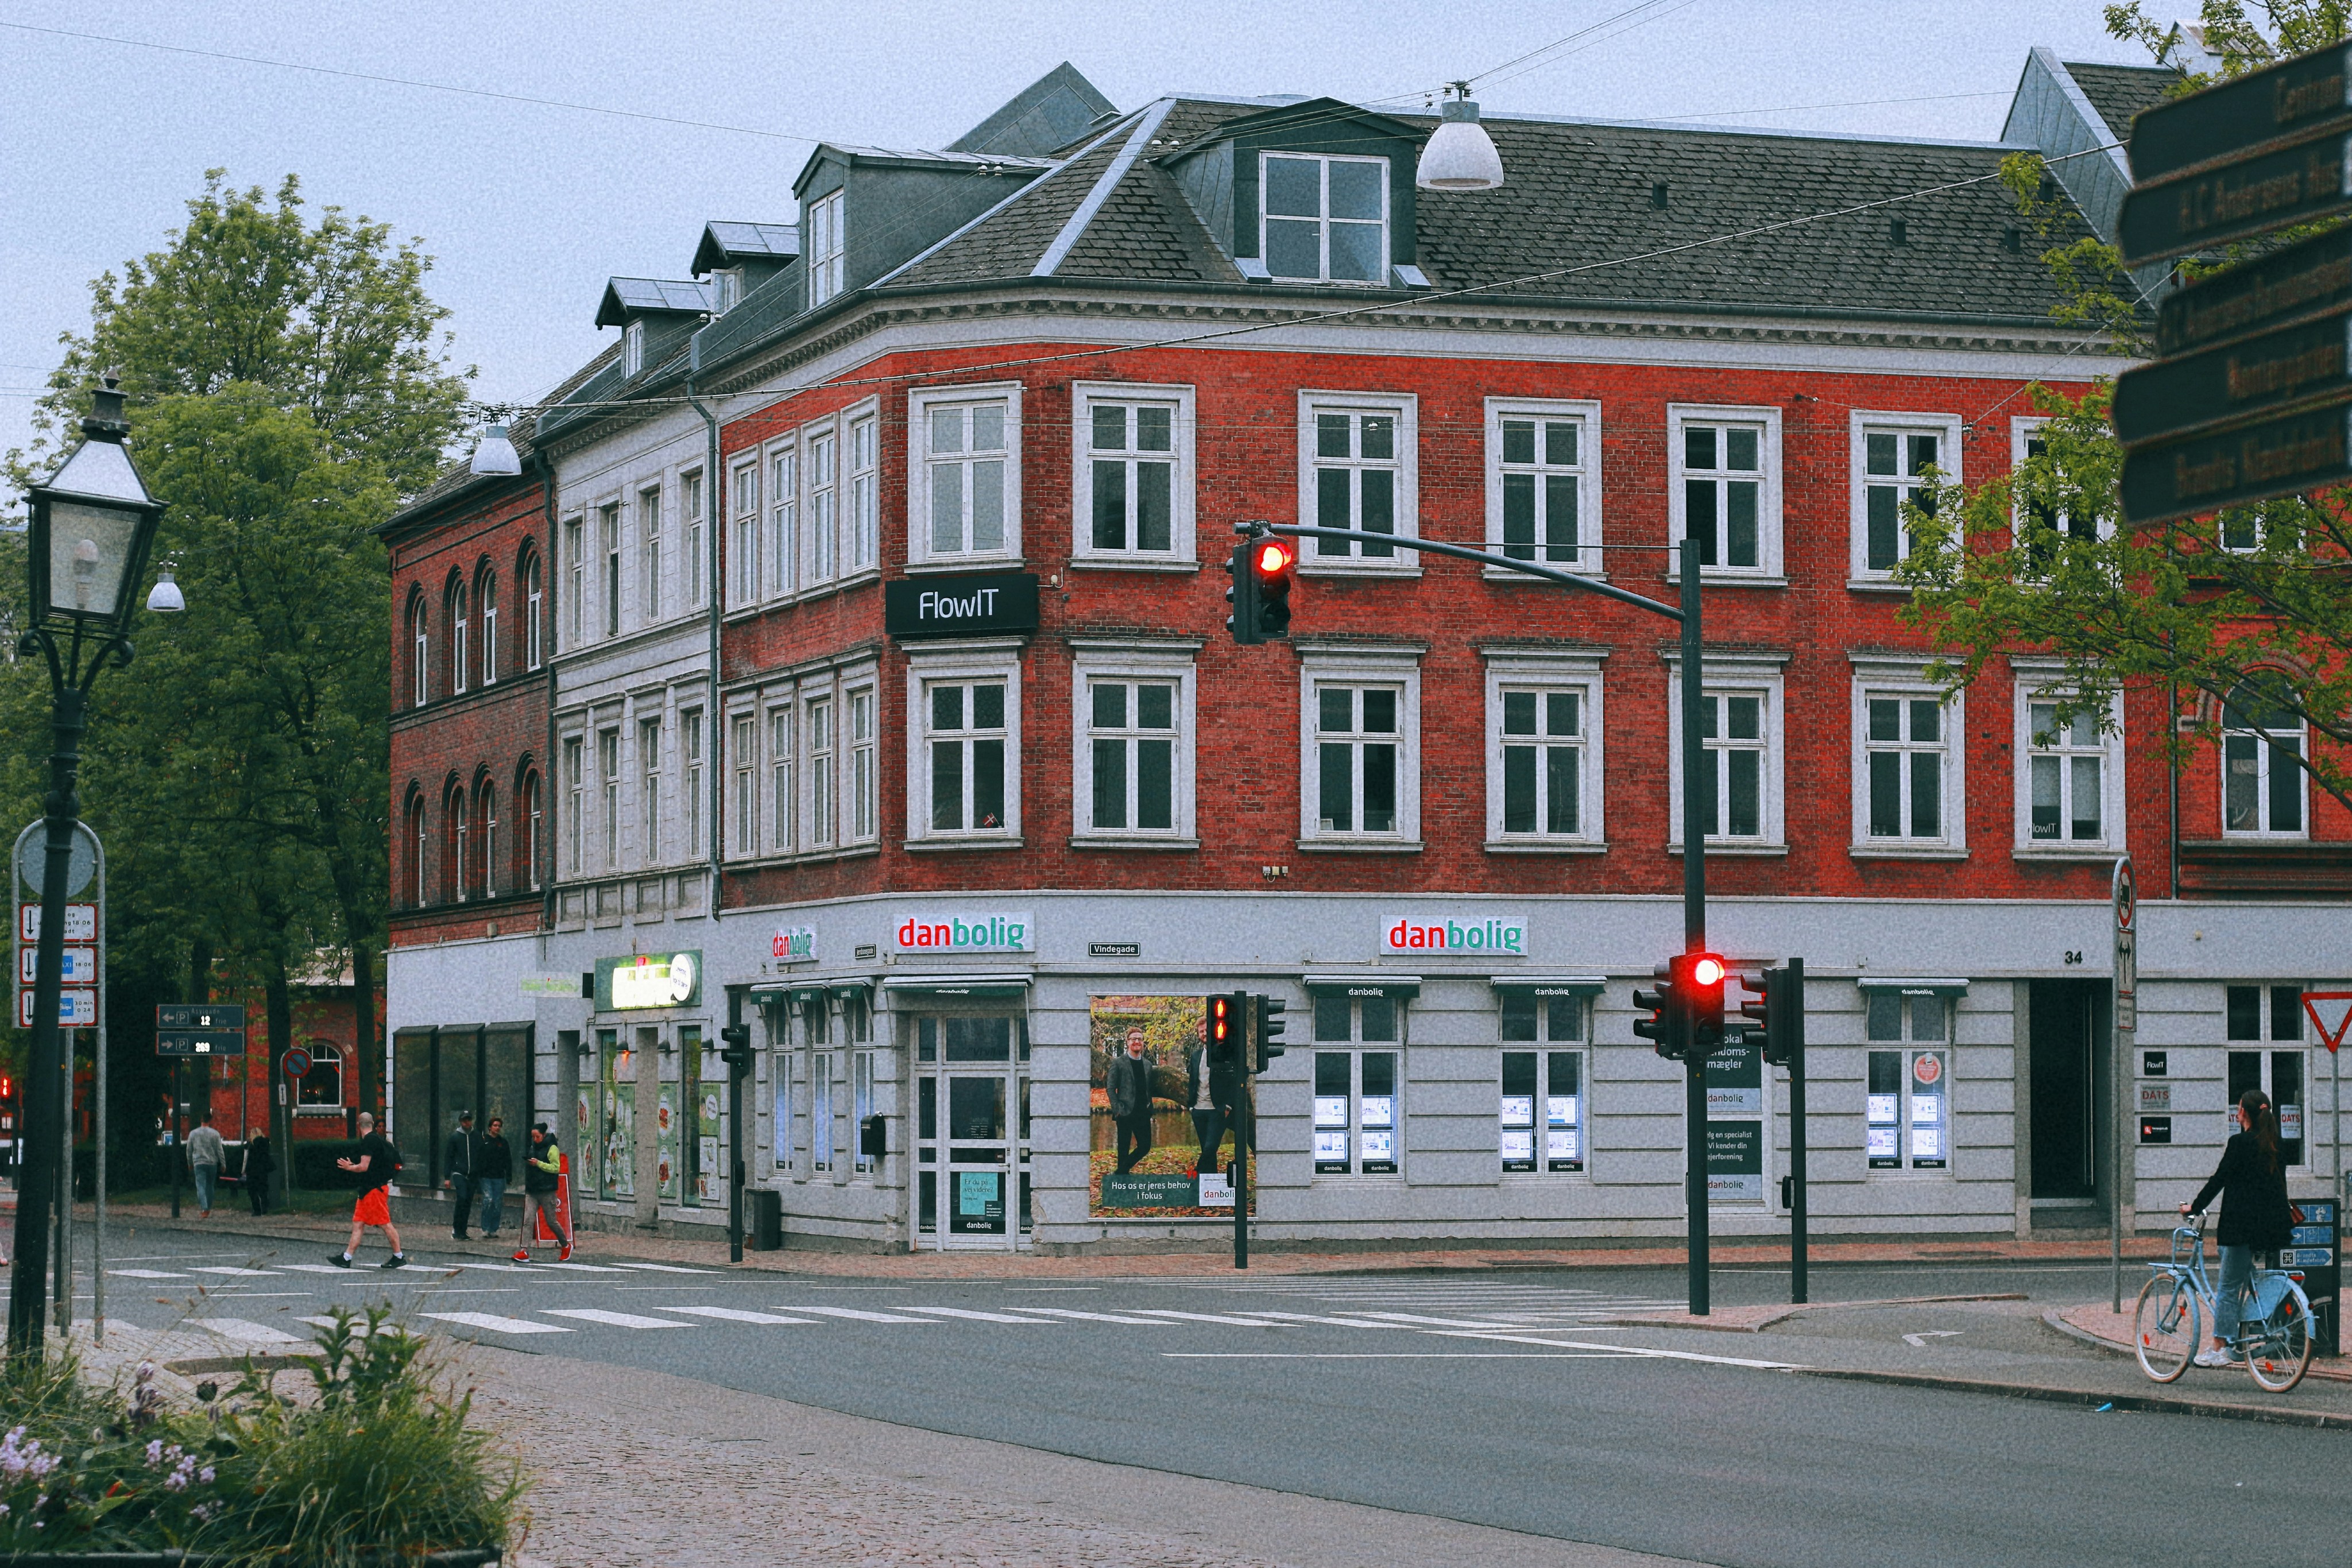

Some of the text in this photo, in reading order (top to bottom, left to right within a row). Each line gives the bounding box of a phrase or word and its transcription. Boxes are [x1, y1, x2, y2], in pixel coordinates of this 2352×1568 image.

[919, 588, 999, 620] FlowIT
[2033, 823, 2057, 833] lowIT
[899, 917, 1024, 950] danbolig
[1390, 920, 1522, 953] danbolig
[773, 927, 813, 957] danbolig
[1094, 945, 1135, 954] Vindegade
[2065, 951, 2083, 964] 34
[1348, 988, 1383, 997] danbolig
[1535, 988, 1569, 996] danbolig
[200, 1015, 211, 1026] 12
[195, 1042, 210, 1052] 269
[1707, 1059, 1742, 1071] mægler
[1708, 1094, 1743, 1103] danbolig
[2142, 1090, 2169, 1099] DATS
[2281, 1114, 2300, 1122] DATS
[1724, 1131, 1752, 1139] specialist
[1708, 1153, 1743, 1161] ejerforening
[1112, 1182, 1126, 1190] Hos
[1147, 1182, 1166, 1191] jeres
[1167, 1181, 1190, 1189] behov
[1708, 1180, 1743, 1189] danbolig
[1141, 1191, 1163, 1199] fokus
[1204, 1190, 1235, 1198] danboli
